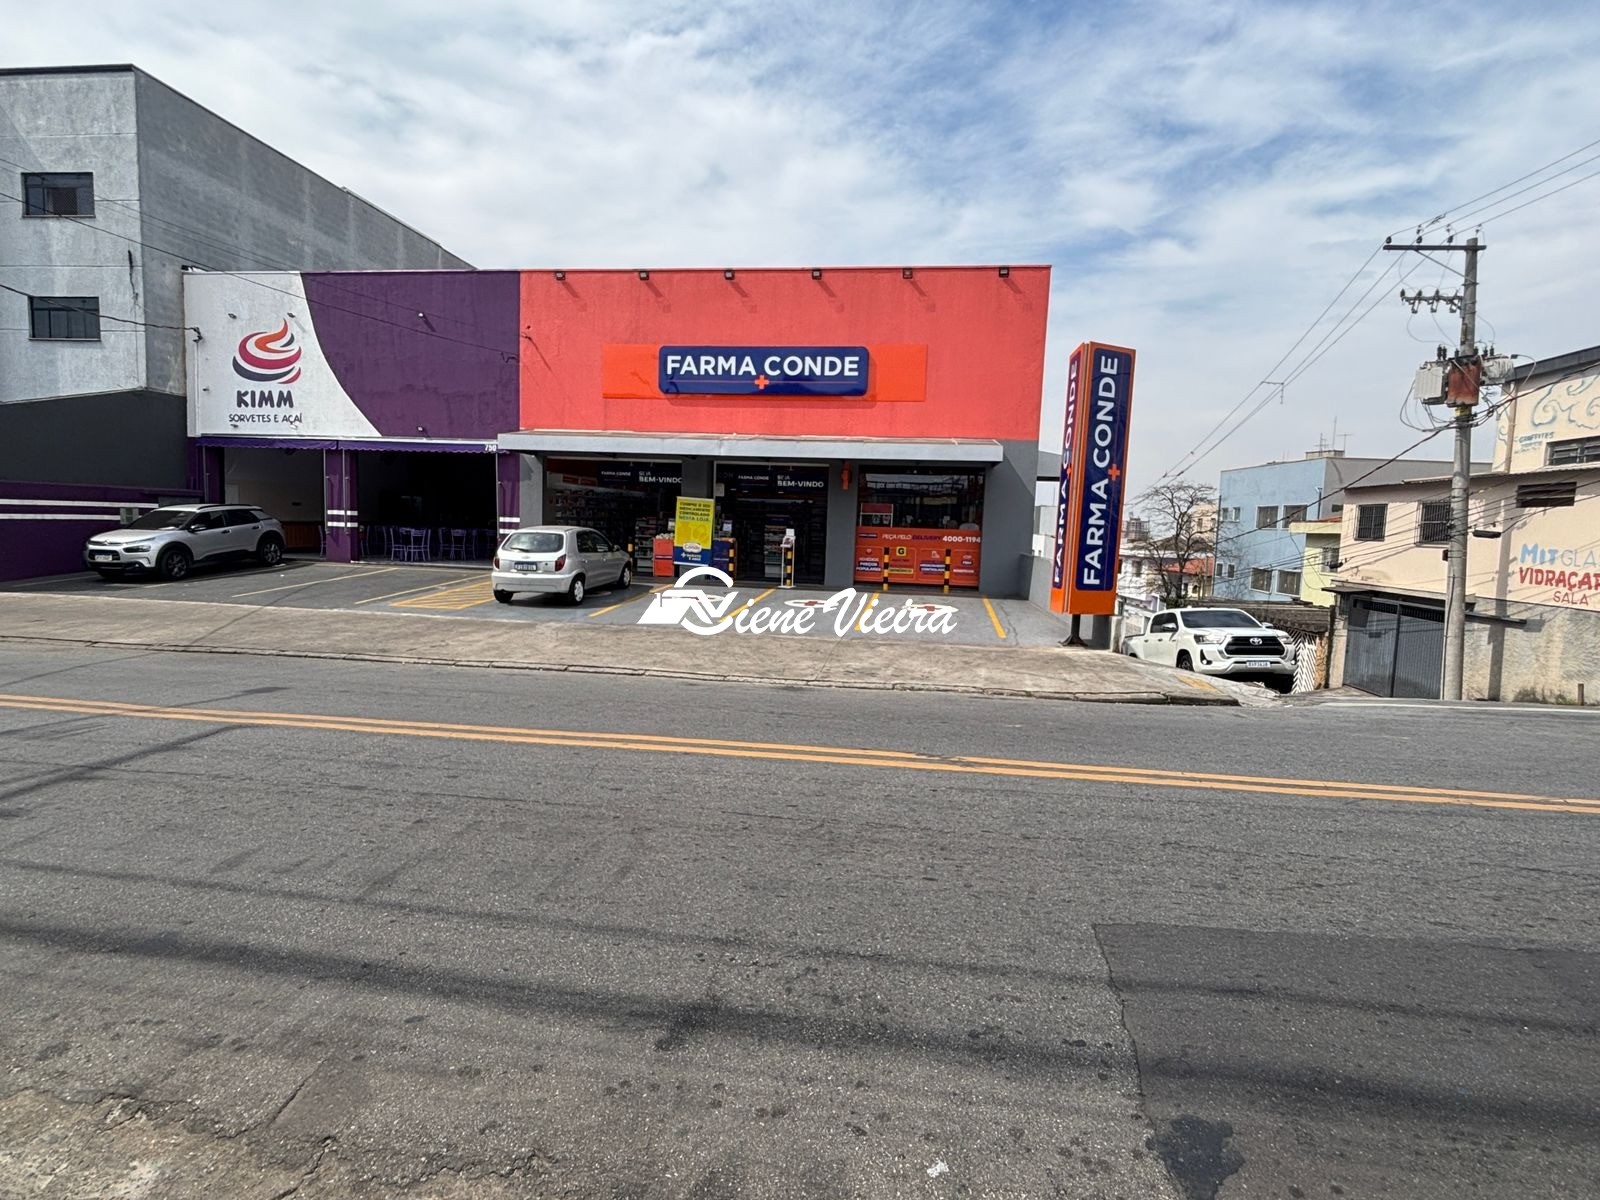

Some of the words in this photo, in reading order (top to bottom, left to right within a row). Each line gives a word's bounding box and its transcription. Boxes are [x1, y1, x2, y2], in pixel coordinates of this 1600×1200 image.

[667, 356, 756, 375] FARMA
[764, 356, 859, 376] CONDE
[237, 390, 294, 408] KIMM
[229, 413, 271, 423] SORVETES
[274, 414, 279, 423] E
[282, 412, 303, 424] AÇAÍ
[1093, 355, 1119, 469] CONDE
[485, 444, 497, 452] 750
[1054, 479, 1067, 584] FARMA
[1063, 359, 1078, 470] CONDE
[777, 480, 824, 488] BEM-VINDO
[942, 535, 981, 543] 4000-1194
[1083, 478, 1109, 585] FARMA
[1553, 590, 1589, 606] SALA
